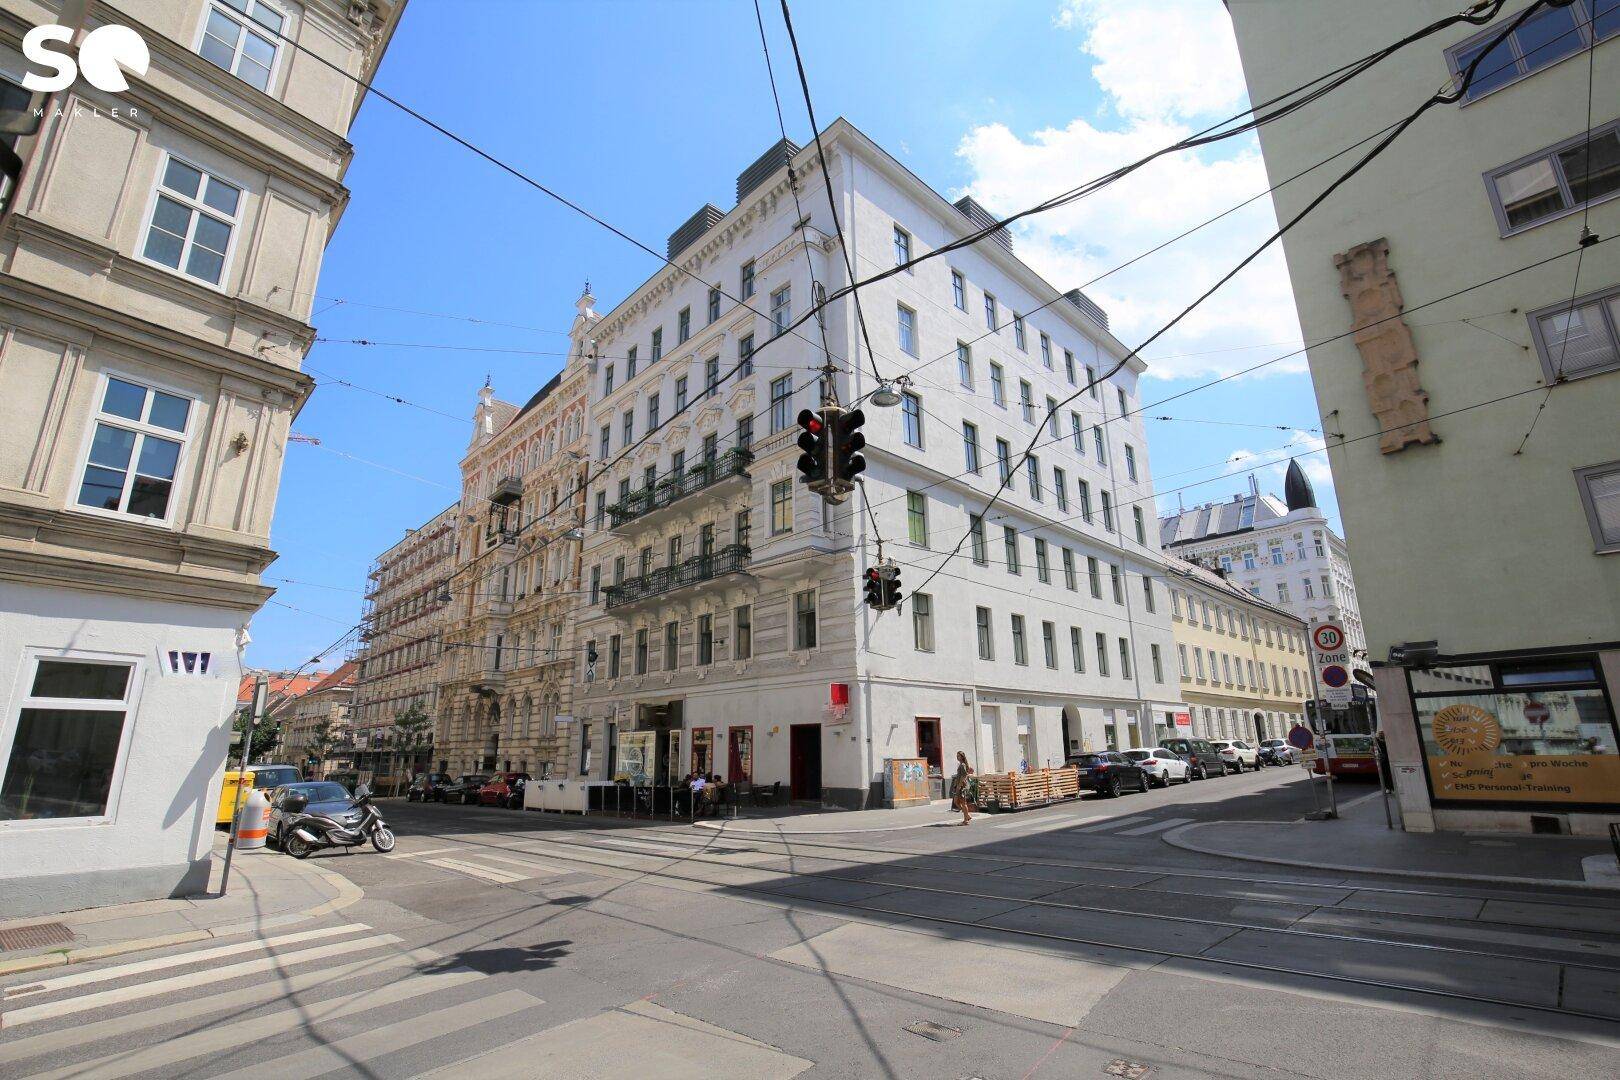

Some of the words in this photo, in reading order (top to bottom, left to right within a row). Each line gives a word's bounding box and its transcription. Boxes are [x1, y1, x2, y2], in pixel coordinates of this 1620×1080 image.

[1320, 631, 1337, 645] 30
[1318, 653, 1346, 664] Zone
[1530, 760, 1548, 770] pro
[1550, 759, 1589, 768] Woche
[1454, 783, 1476, 792] EMS
[1478, 783, 1572, 794] Personal-Training
